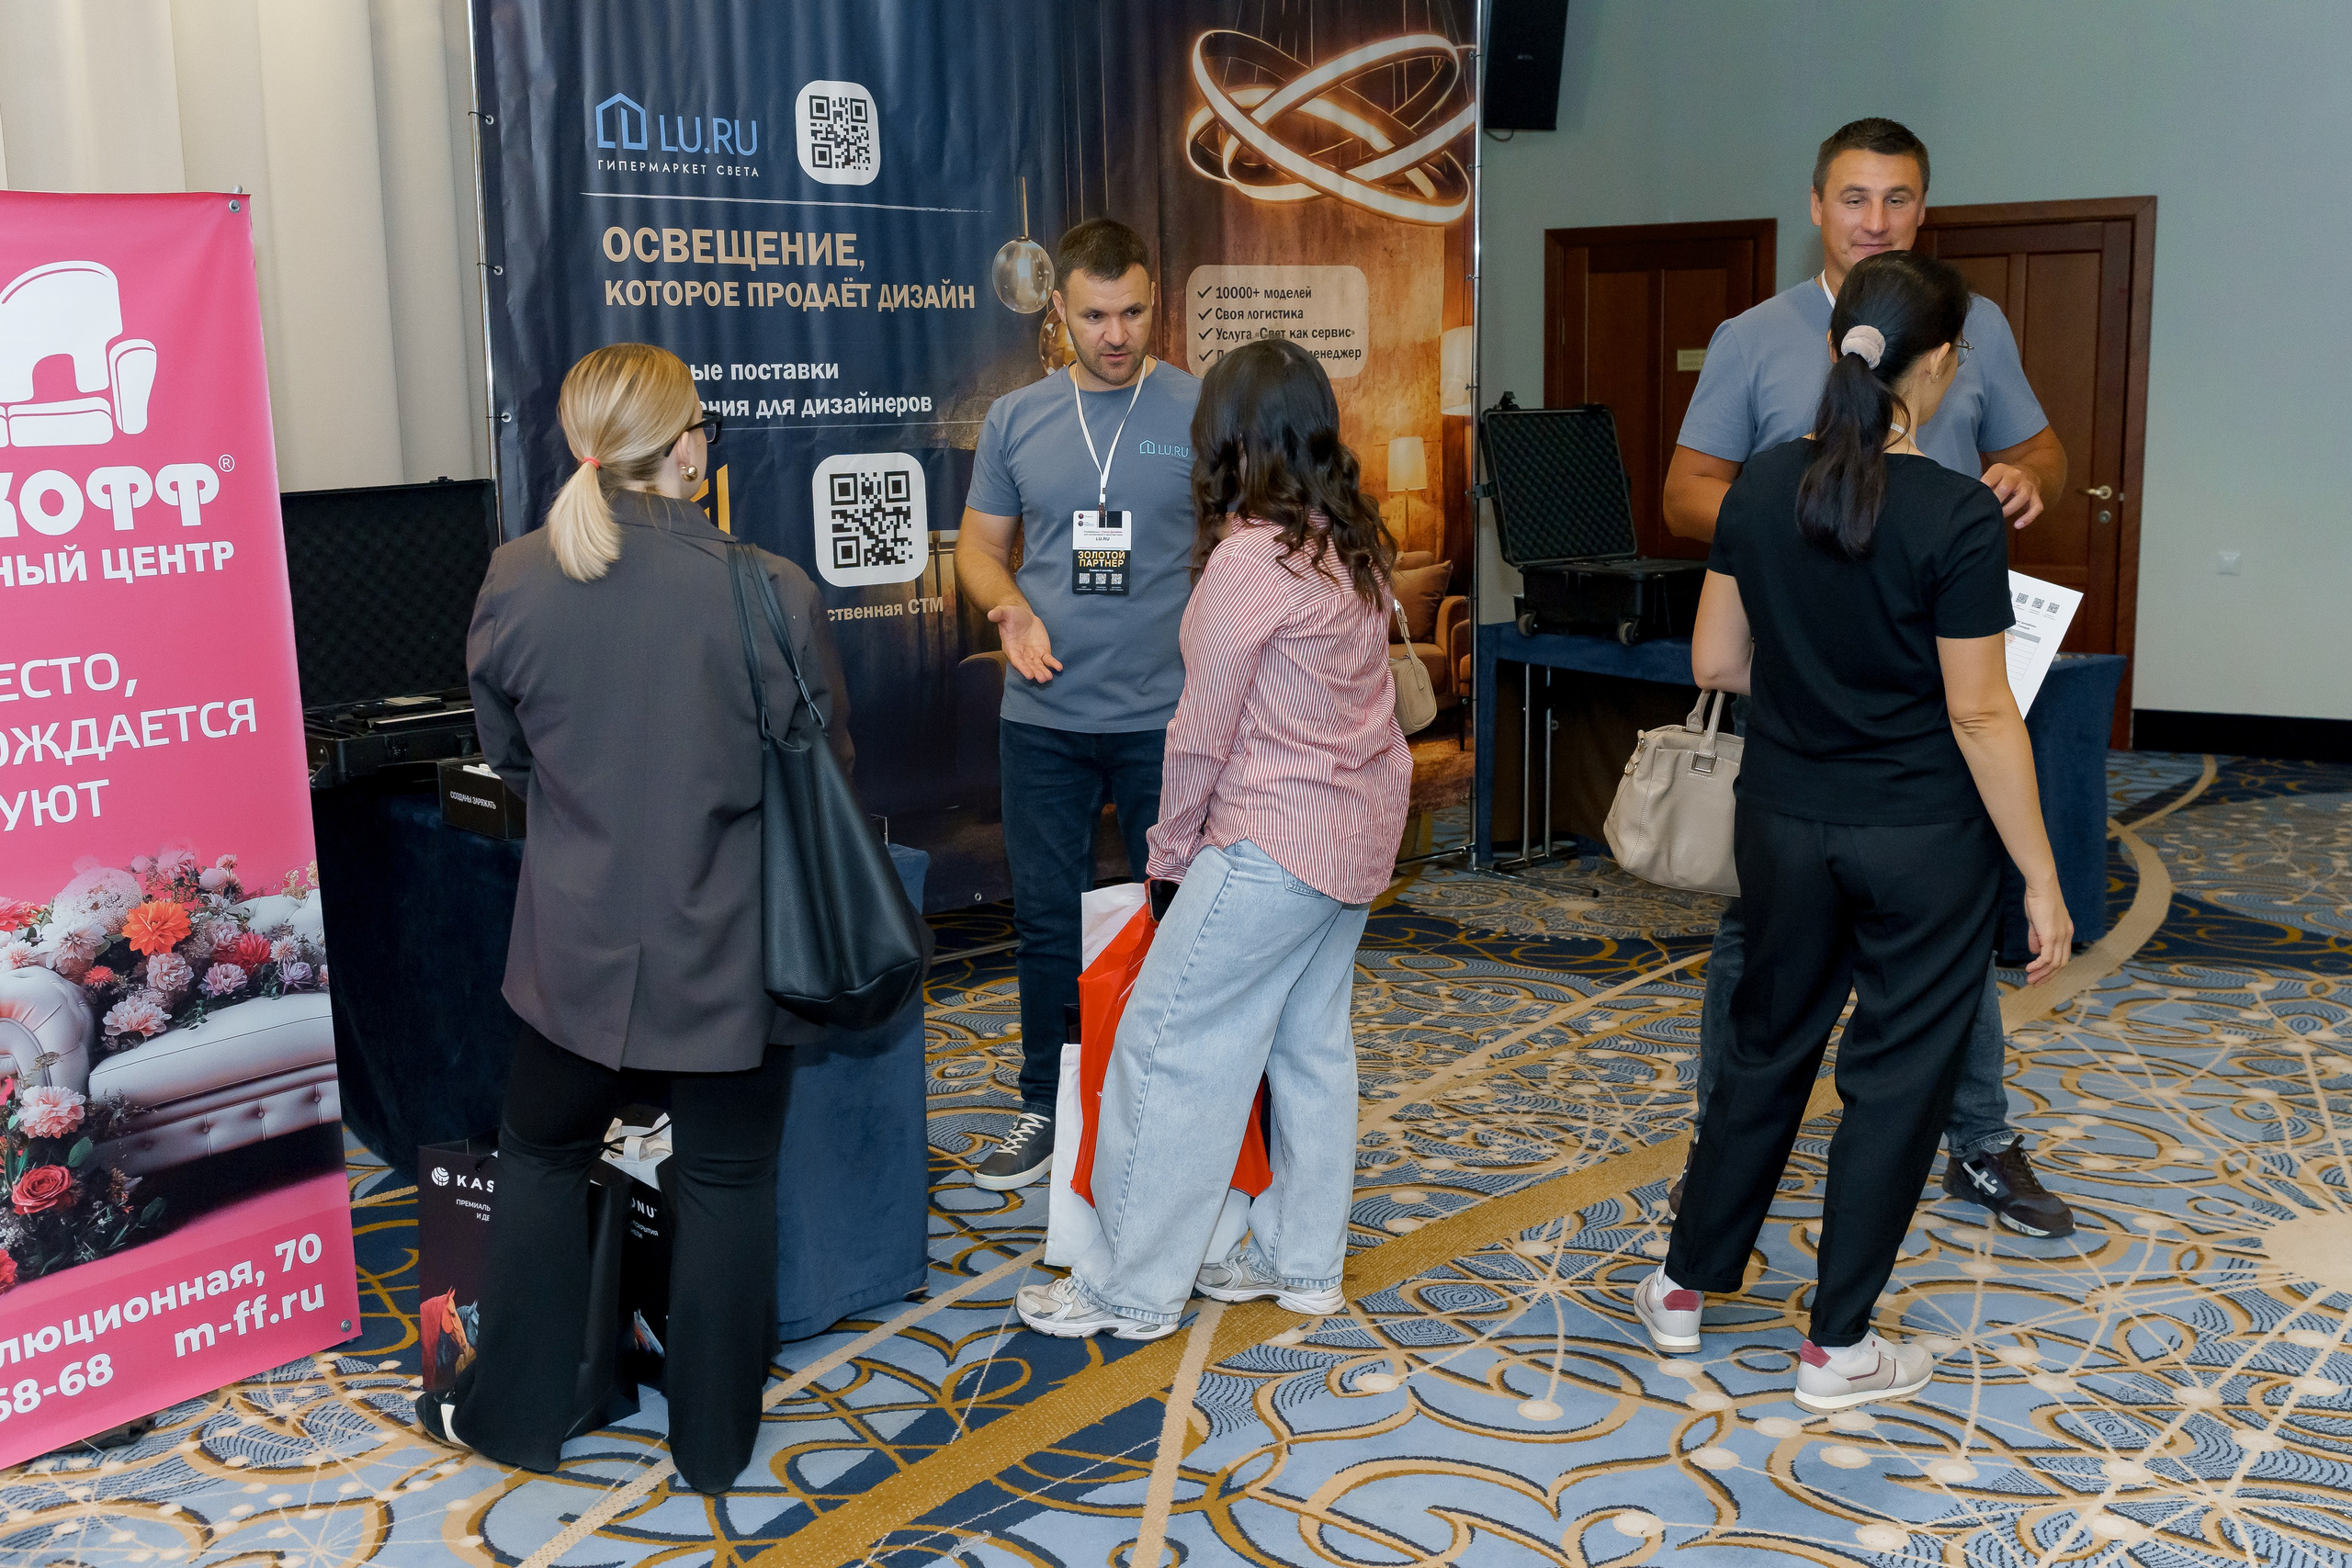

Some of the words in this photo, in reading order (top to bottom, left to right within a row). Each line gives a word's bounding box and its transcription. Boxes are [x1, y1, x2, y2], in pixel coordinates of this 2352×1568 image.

[659, 114, 758, 156] LU.RU
[597, 159, 707, 175] ГИПЕРМАРКЕТ
[716, 164, 760, 177] СВЕТА
[602, 225, 865, 272] ОСВЕЩЕНИЕ,
[605, 278, 740, 307] КОТОРОЕ
[747, 276, 871, 312] ПРОДАЁТ
[877, 278, 976, 313] ДИЗАЙН
[1216, 286, 1261, 299] 10000+
[1263, 286, 1312, 300] моделей
[1215, 307, 1245, 321] Своя
[1247, 309, 1304, 321] логистика
[1216, 327, 1252, 343] Услуга
[1289, 328, 1309, 339] как
[1309, 348, 1362, 361] енеджер
[730, 362, 839, 380] поставки
[755, 399, 796, 420] для
[801, 390, 933, 418] дизайнеров
[1158, 444, 1189, 457] LU.RU
[101, 540, 234, 584] ЦЕНТР
[1078, 549, 1125, 559] ЗОЛОТОЙ
[1079, 558, 1125, 568] ПАРТНЕР
[908, 596, 944, 615] СТМ
[0, 779, 109, 832] УЮТ
[274, 1233, 322, 1273] 70
[174, 1283, 325, 1358] m-ff.ru
